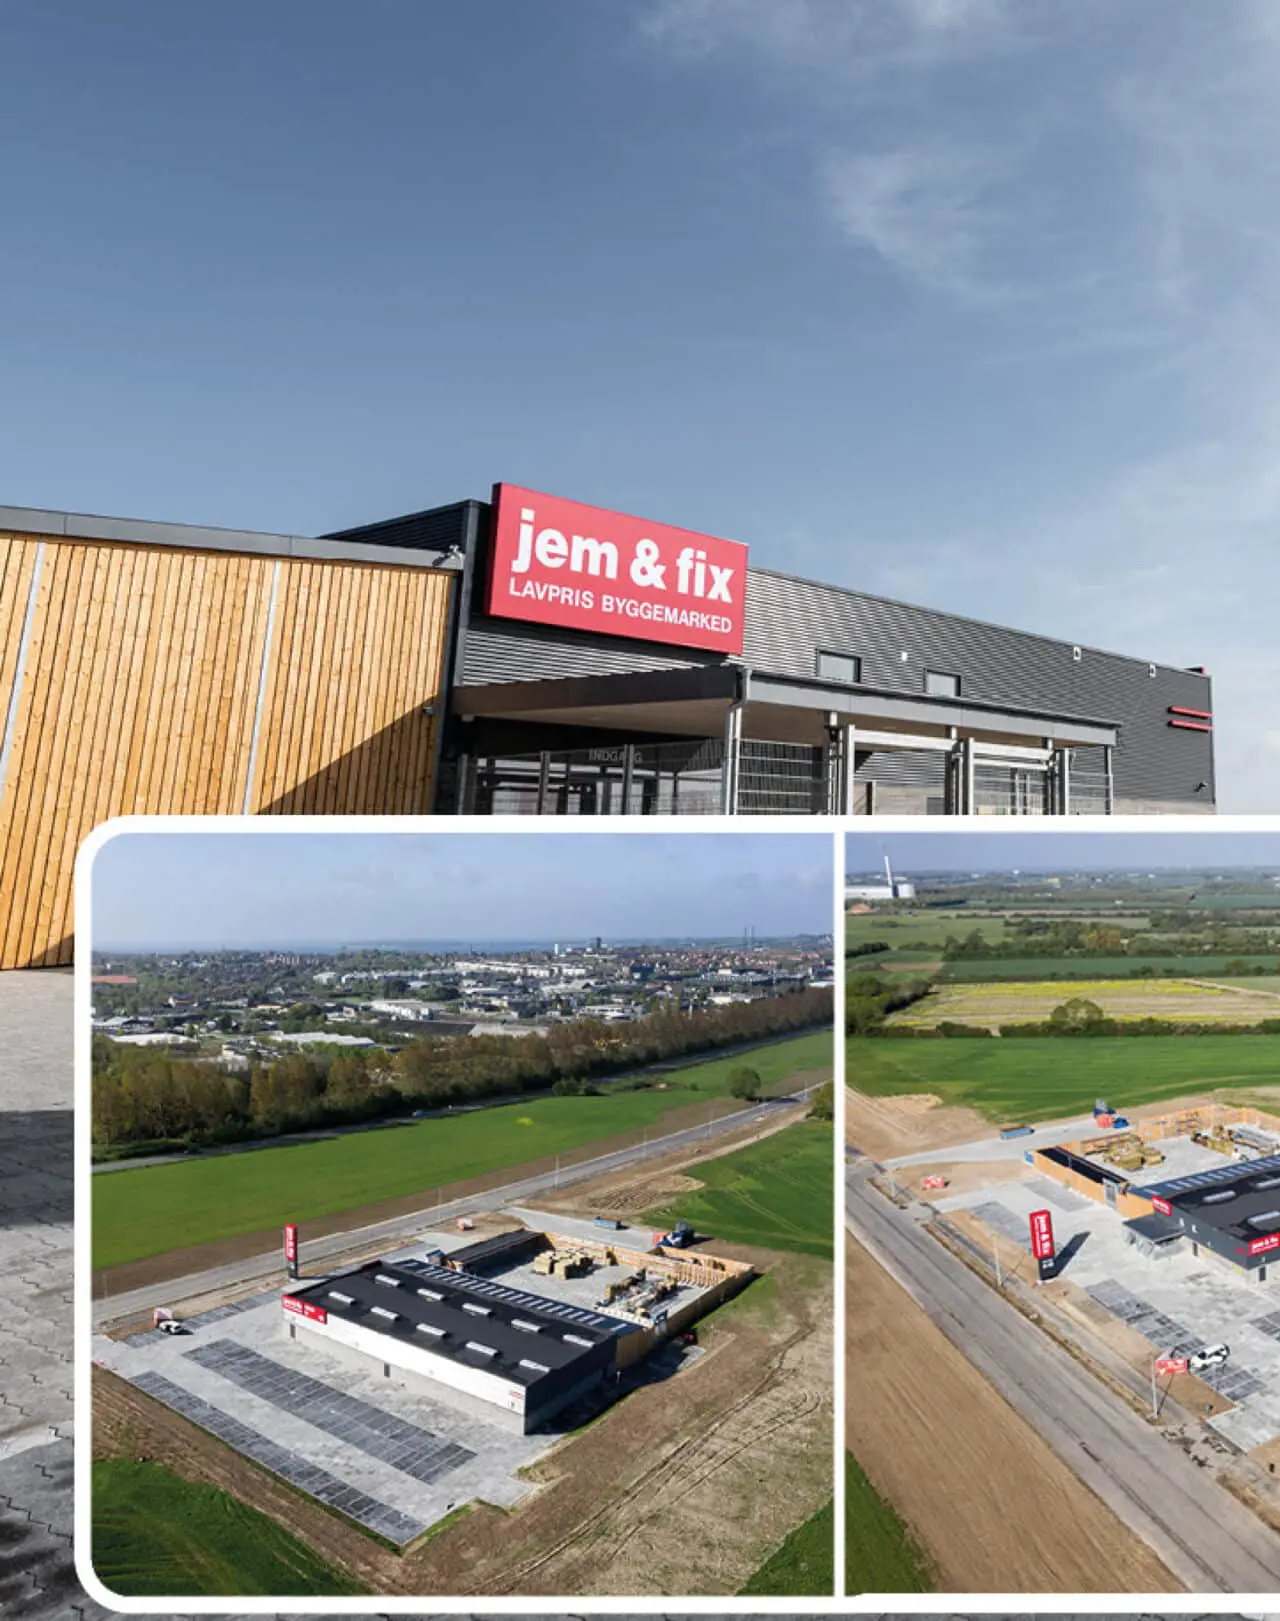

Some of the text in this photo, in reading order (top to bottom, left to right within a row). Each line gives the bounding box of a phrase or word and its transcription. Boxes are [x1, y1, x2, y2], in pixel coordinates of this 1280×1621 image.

[510, 507, 736, 604] jem & fix
[508, 577, 733, 634] LAVPRIS BYGGEMARKED
